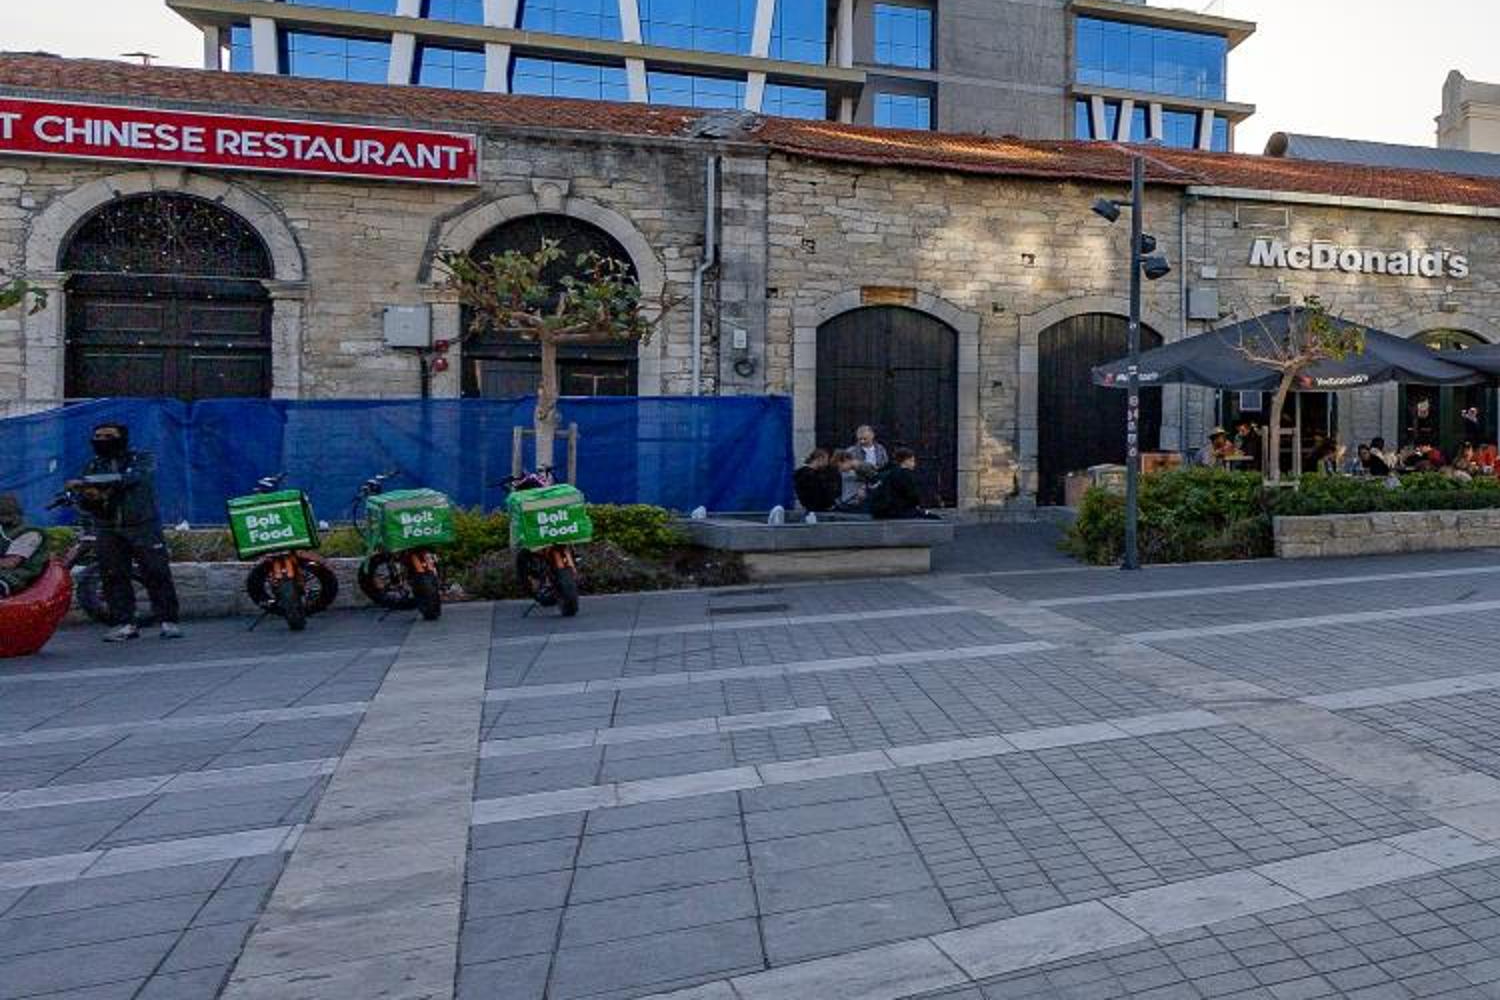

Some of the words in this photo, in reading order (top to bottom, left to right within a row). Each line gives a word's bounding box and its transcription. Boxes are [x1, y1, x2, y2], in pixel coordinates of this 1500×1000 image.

[33, 115, 206, 153] CHINESE
[215, 128, 464, 171] RESTAURANT
[1249, 238, 1470, 279] McDonald's
[245, 513, 282, 529] Bolt
[400, 509, 433, 525] Bolt
[537, 509, 568, 525] Bolt
[249, 525, 294, 543] Food
[403, 522, 442, 538] Food
[539, 522, 579, 538] Food
